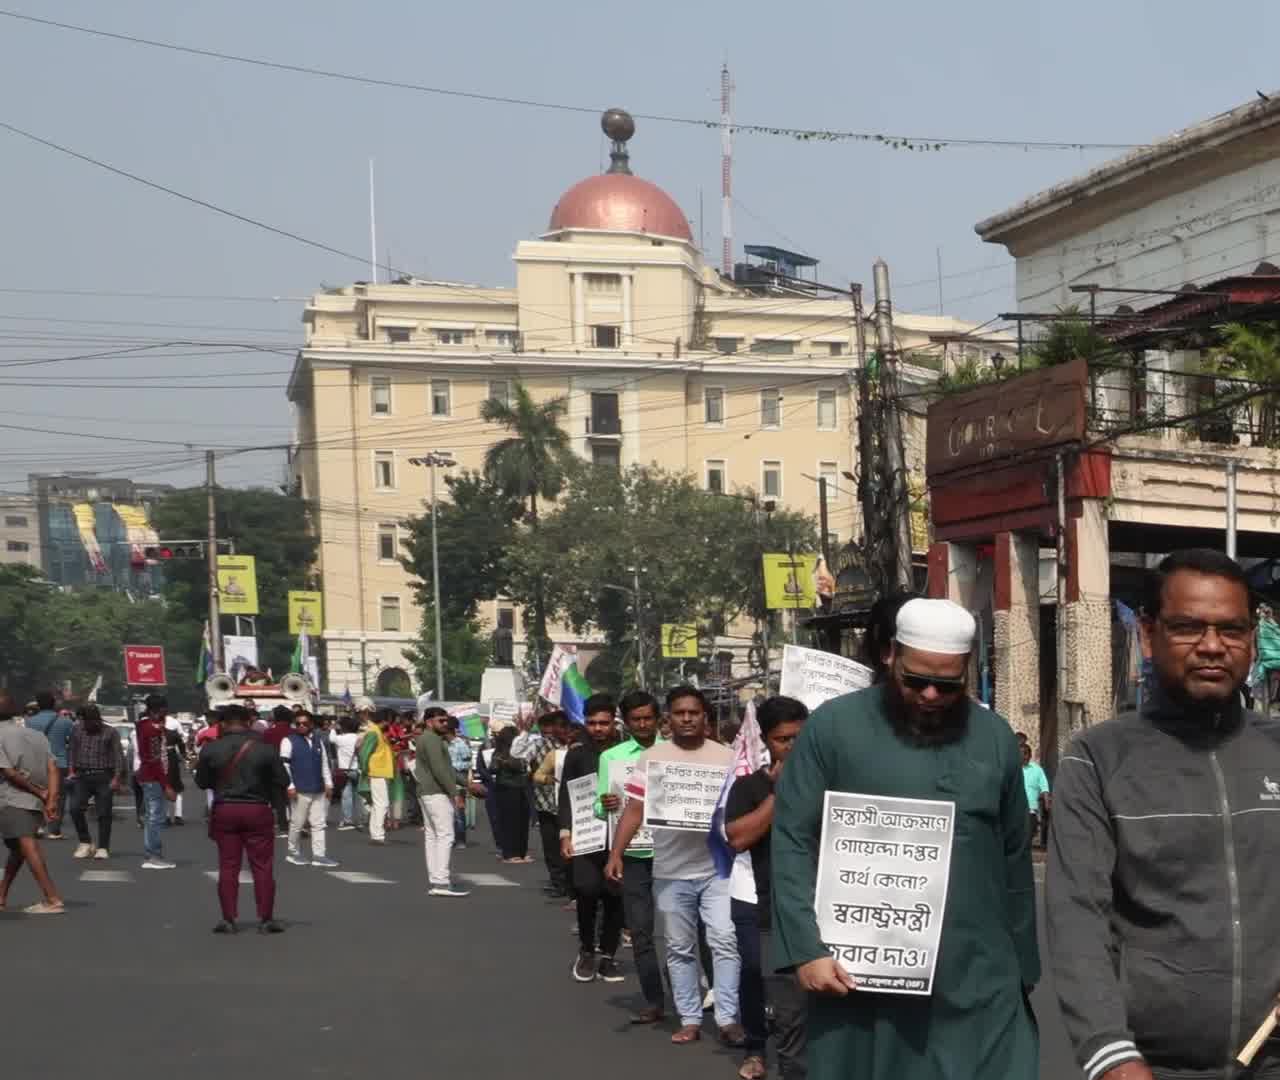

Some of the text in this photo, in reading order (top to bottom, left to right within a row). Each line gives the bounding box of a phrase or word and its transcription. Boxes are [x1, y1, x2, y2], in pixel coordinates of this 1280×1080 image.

[832, 806, 948, 830] সন্ত্রাসী আক্রমণে
[835, 839, 940, 861] গোয়েন্দা দপ্তর
[839, 865, 929, 890] ব্যর্থ কেনো?
[832, 902, 932, 932] স্বরাষ্ট্রমন্ত্রী
